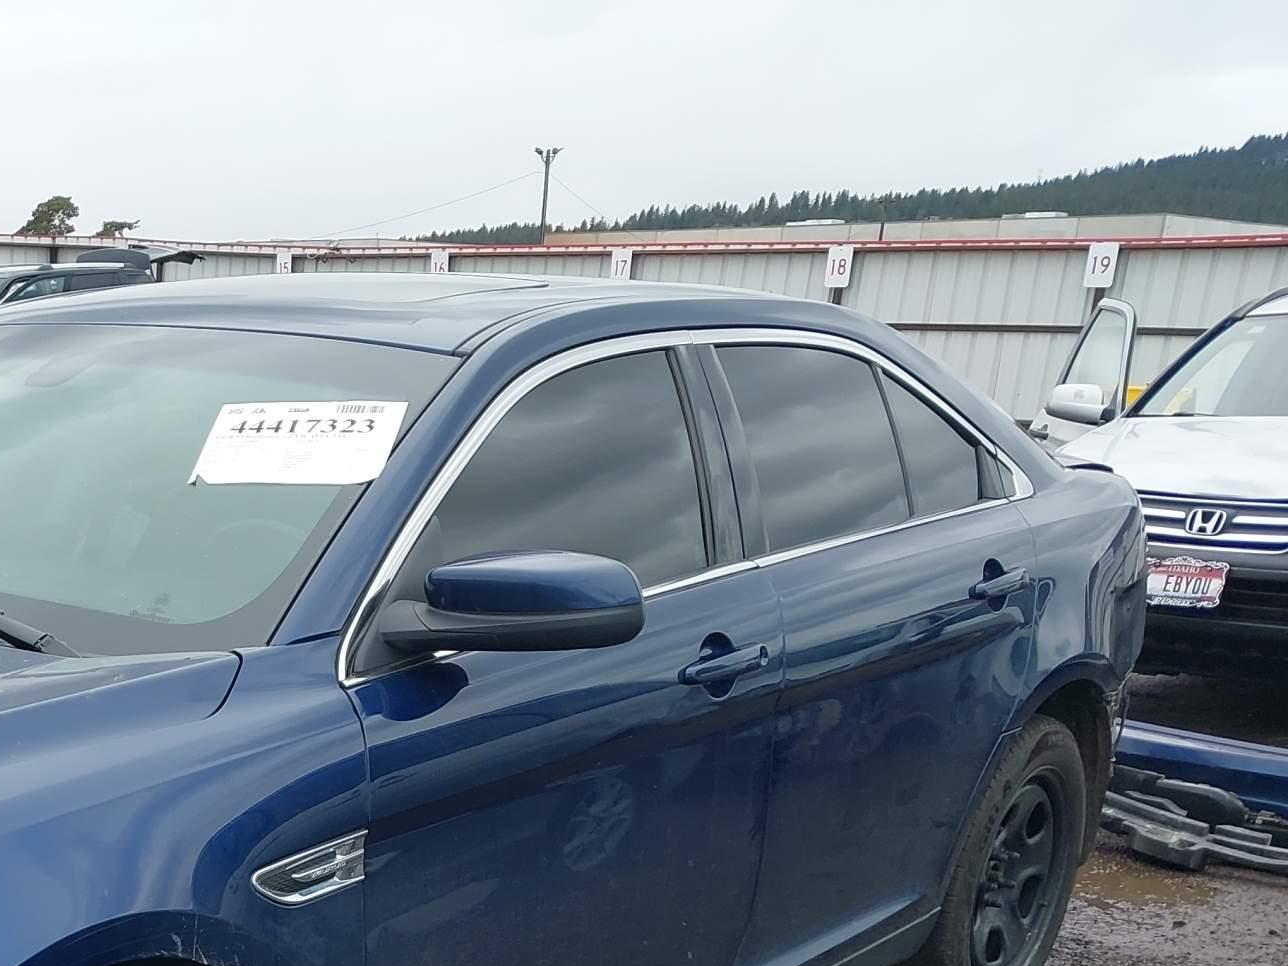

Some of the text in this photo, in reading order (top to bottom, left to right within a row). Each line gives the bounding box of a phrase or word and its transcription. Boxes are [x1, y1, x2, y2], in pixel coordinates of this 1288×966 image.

[614, 259, 628, 276] 17
[830, 258, 847, 276] 18
[1091, 255, 1111, 274] 19
[230, 418, 376, 434] 44417323
[1163, 574, 1212, 595] EBYOU
